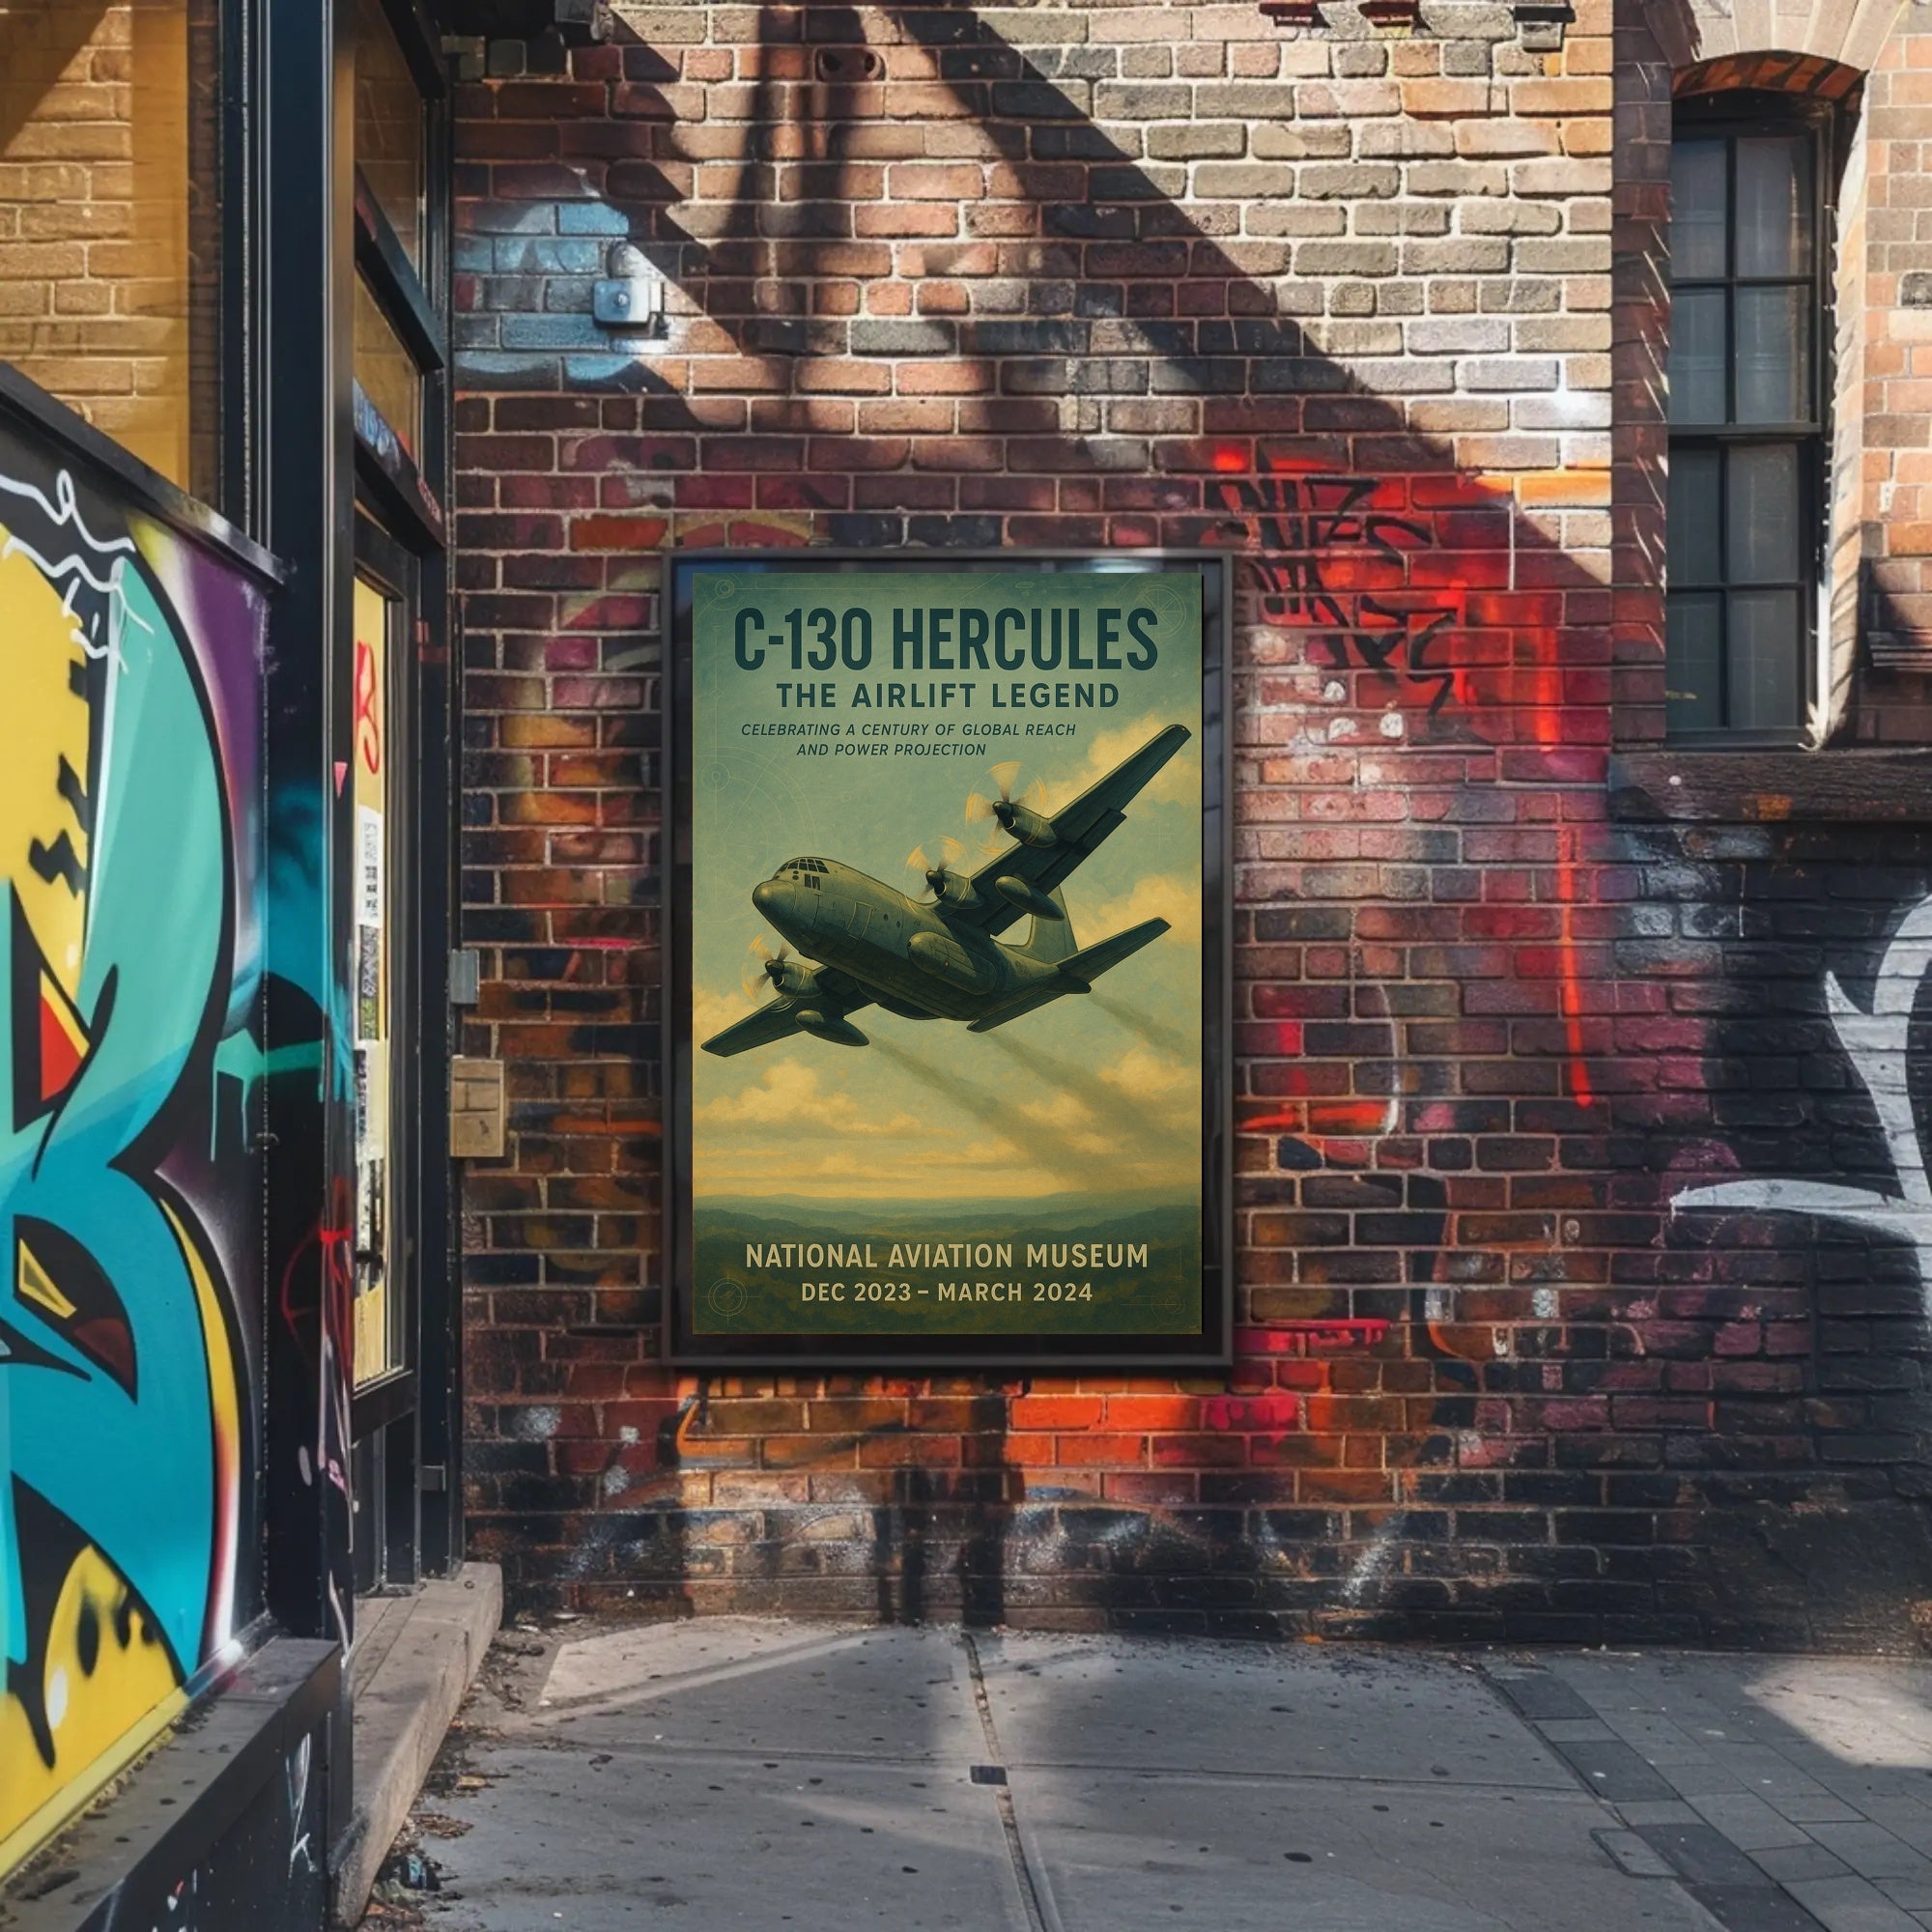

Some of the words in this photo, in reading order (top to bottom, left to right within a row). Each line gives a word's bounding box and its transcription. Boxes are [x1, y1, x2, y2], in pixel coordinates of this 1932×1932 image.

[735, 608, 872, 670] C-130
[893, 608, 1158, 670] HERCULES
[777, 683, 837, 708] THE
[851, 683, 977, 708] AIRLIFT
[992, 683, 1119, 708] LEGEND
[741, 724, 840, 736] CELEBRATING
[845, 724, 855, 736] A
[862, 724, 929, 736] CENTURY
[935, 724, 956, 736] OF
[962, 724, 1020, 736] GLOBAL
[1025, 724, 1076, 736] REACH
[797, 743, 829, 756] AND
[835, 743, 889, 756] POWER
[894, 743, 986, 756] PROJECTION
[746, 1243, 878, 1268] NATIONAL
[888, 1243, 1012, 1268] AVIATION
[1027, 1243, 1148, 1268] MUSEUM
[802, 1282, 845, 1302] DEC
[938, 1282, 1022, 1302] MARCH
[1033, 1282, 1093, 1302] 2024
